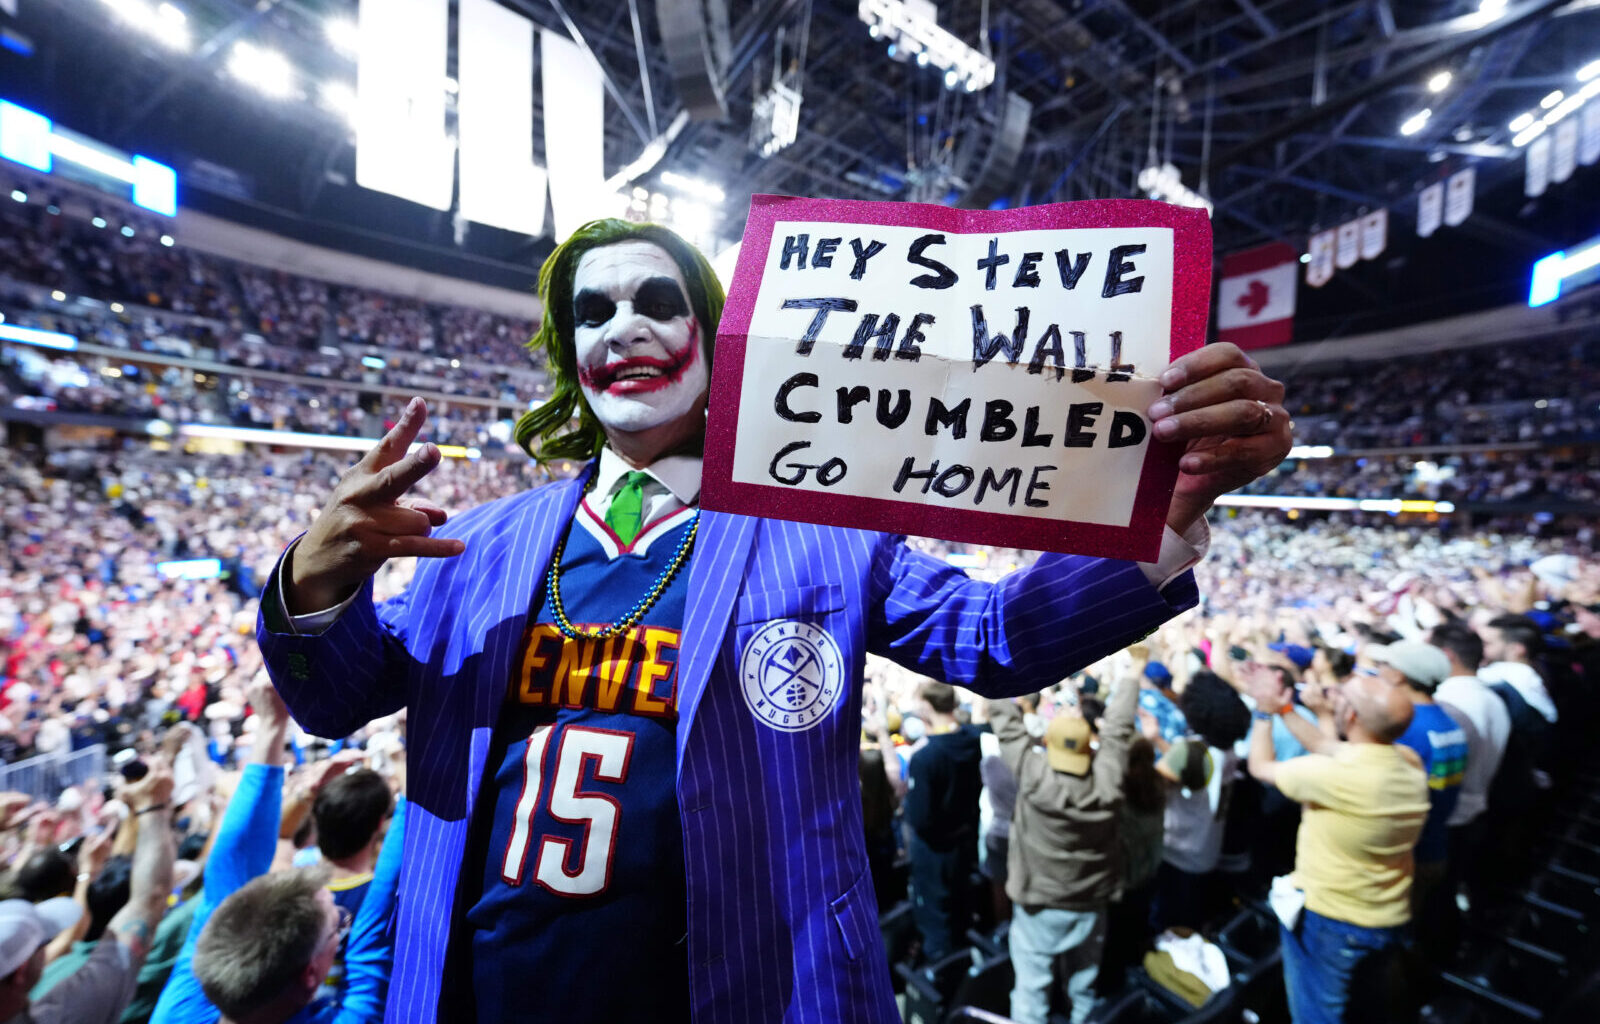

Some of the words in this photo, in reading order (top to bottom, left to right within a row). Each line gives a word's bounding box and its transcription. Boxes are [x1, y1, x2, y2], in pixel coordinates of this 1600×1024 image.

[780, 233, 887, 281] HEY
[781, 297, 936, 361] THE
[969, 303, 1136, 383] WALL
[892, 456, 1057, 507] HOME
[752, 624, 825, 656] DENVER
[505, 622, 682, 716] ENVE
[755, 687, 833, 724] NUGGETS
[501, 723, 636, 897] 15
